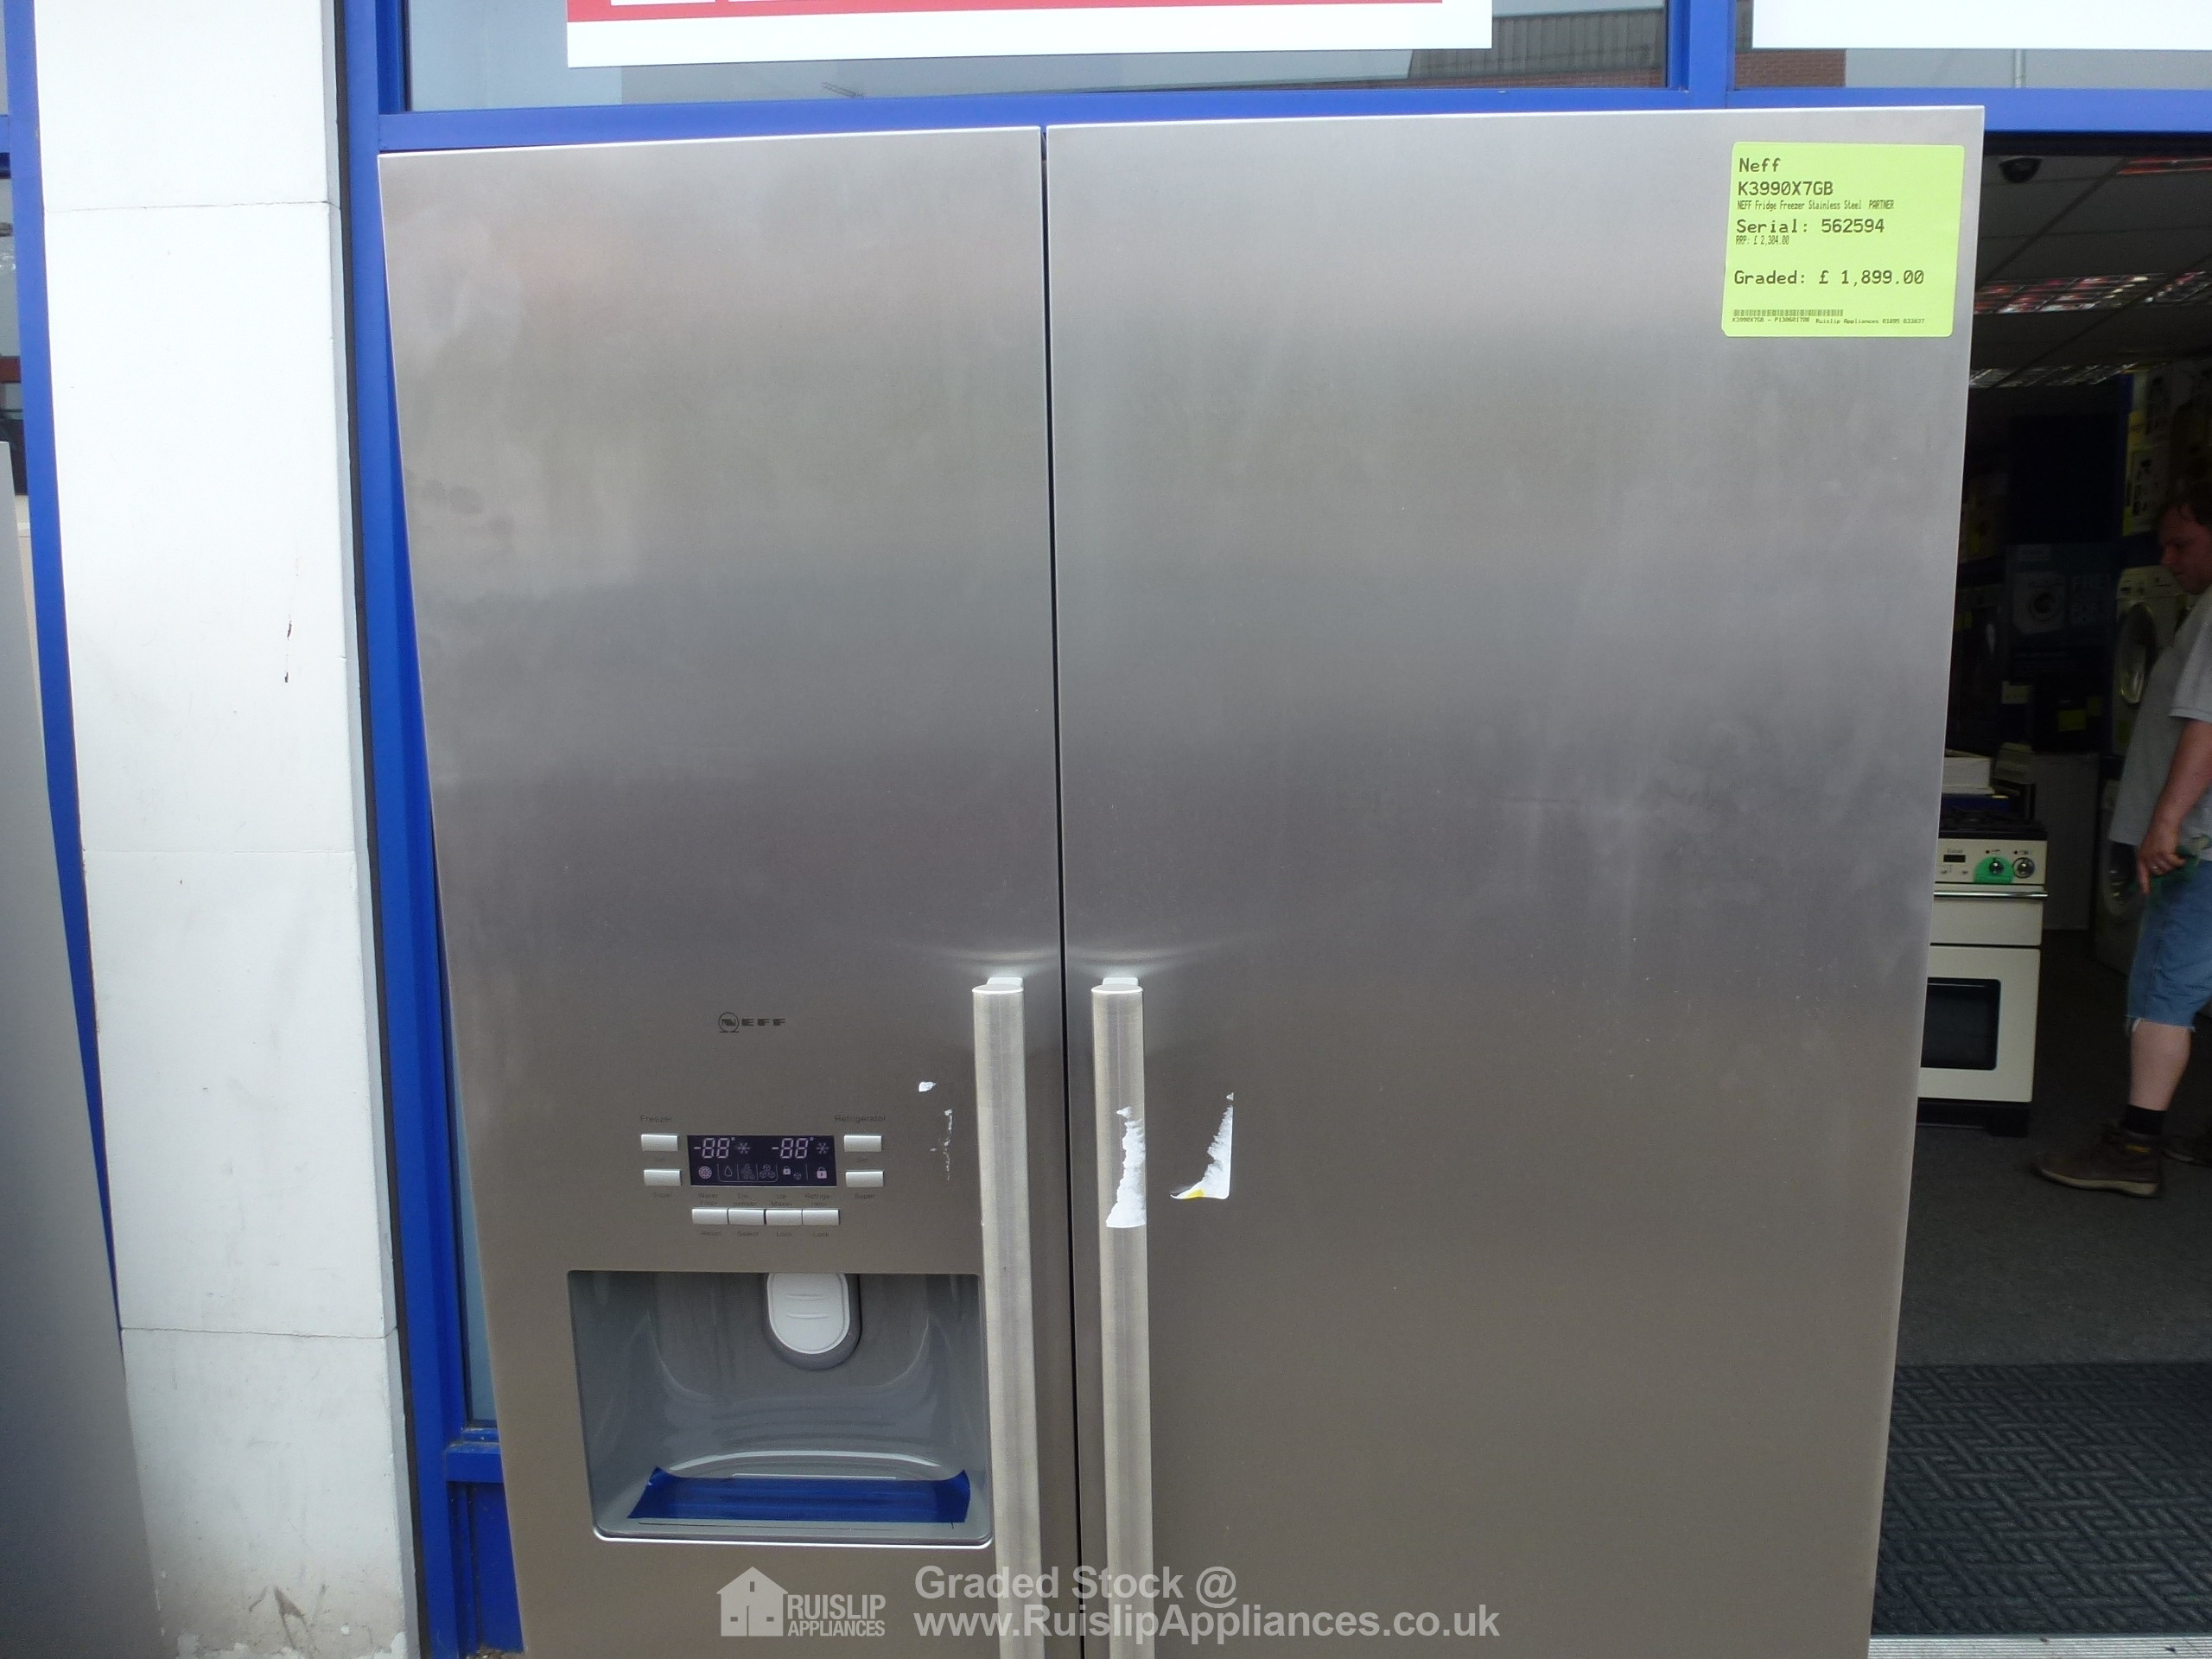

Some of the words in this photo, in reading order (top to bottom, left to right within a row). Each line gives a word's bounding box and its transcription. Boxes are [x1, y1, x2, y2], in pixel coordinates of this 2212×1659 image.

[1739, 157, 1781, 173] Neff
[1738, 181, 1834, 196] K3990X7GB
[1737, 200, 1751, 210] NEFF
[1755, 200, 1777, 212] Fridge
[1780, 200, 1805, 210] Freezer
[1808, 199, 1840, 210] Stainless
[1844, 199, 1862, 210] Steel
[1868, 199, 1895, 209] PARTNER
[1736, 218, 1808, 233] Serial:
[1821, 218, 1885, 233] 562594
[1735, 235, 1750, 245] RRP:
[1760, 234, 1789, 246] 2,304.00
[1733, 270, 1805, 285] Graded:
[1819, 270, 1829, 285] £
[1841, 270, 1924, 287] 1,899.00
[718, 1012, 785, 1033] NEFF
[835, 1115, 886, 1123] Refrigerator
